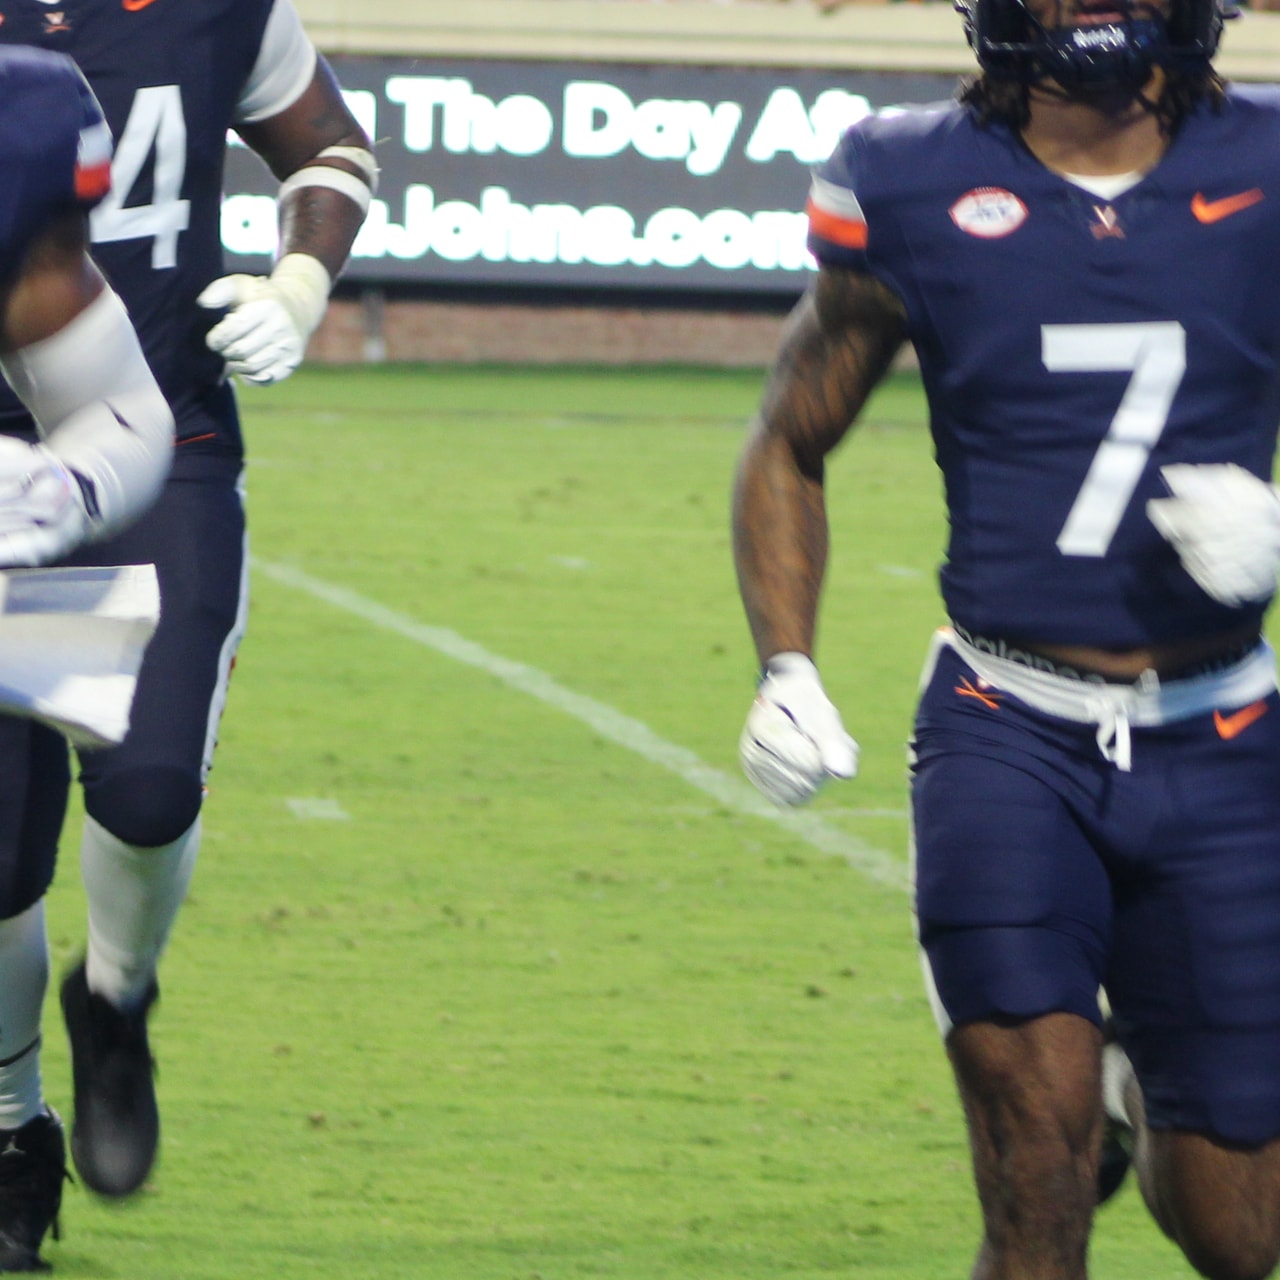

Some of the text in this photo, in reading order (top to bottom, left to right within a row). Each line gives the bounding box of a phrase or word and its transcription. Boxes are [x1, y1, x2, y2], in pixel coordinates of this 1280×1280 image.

[384, 76, 554, 156] The
[562, 81, 743, 176] Day
[1040, 320, 1187, 557] 7
